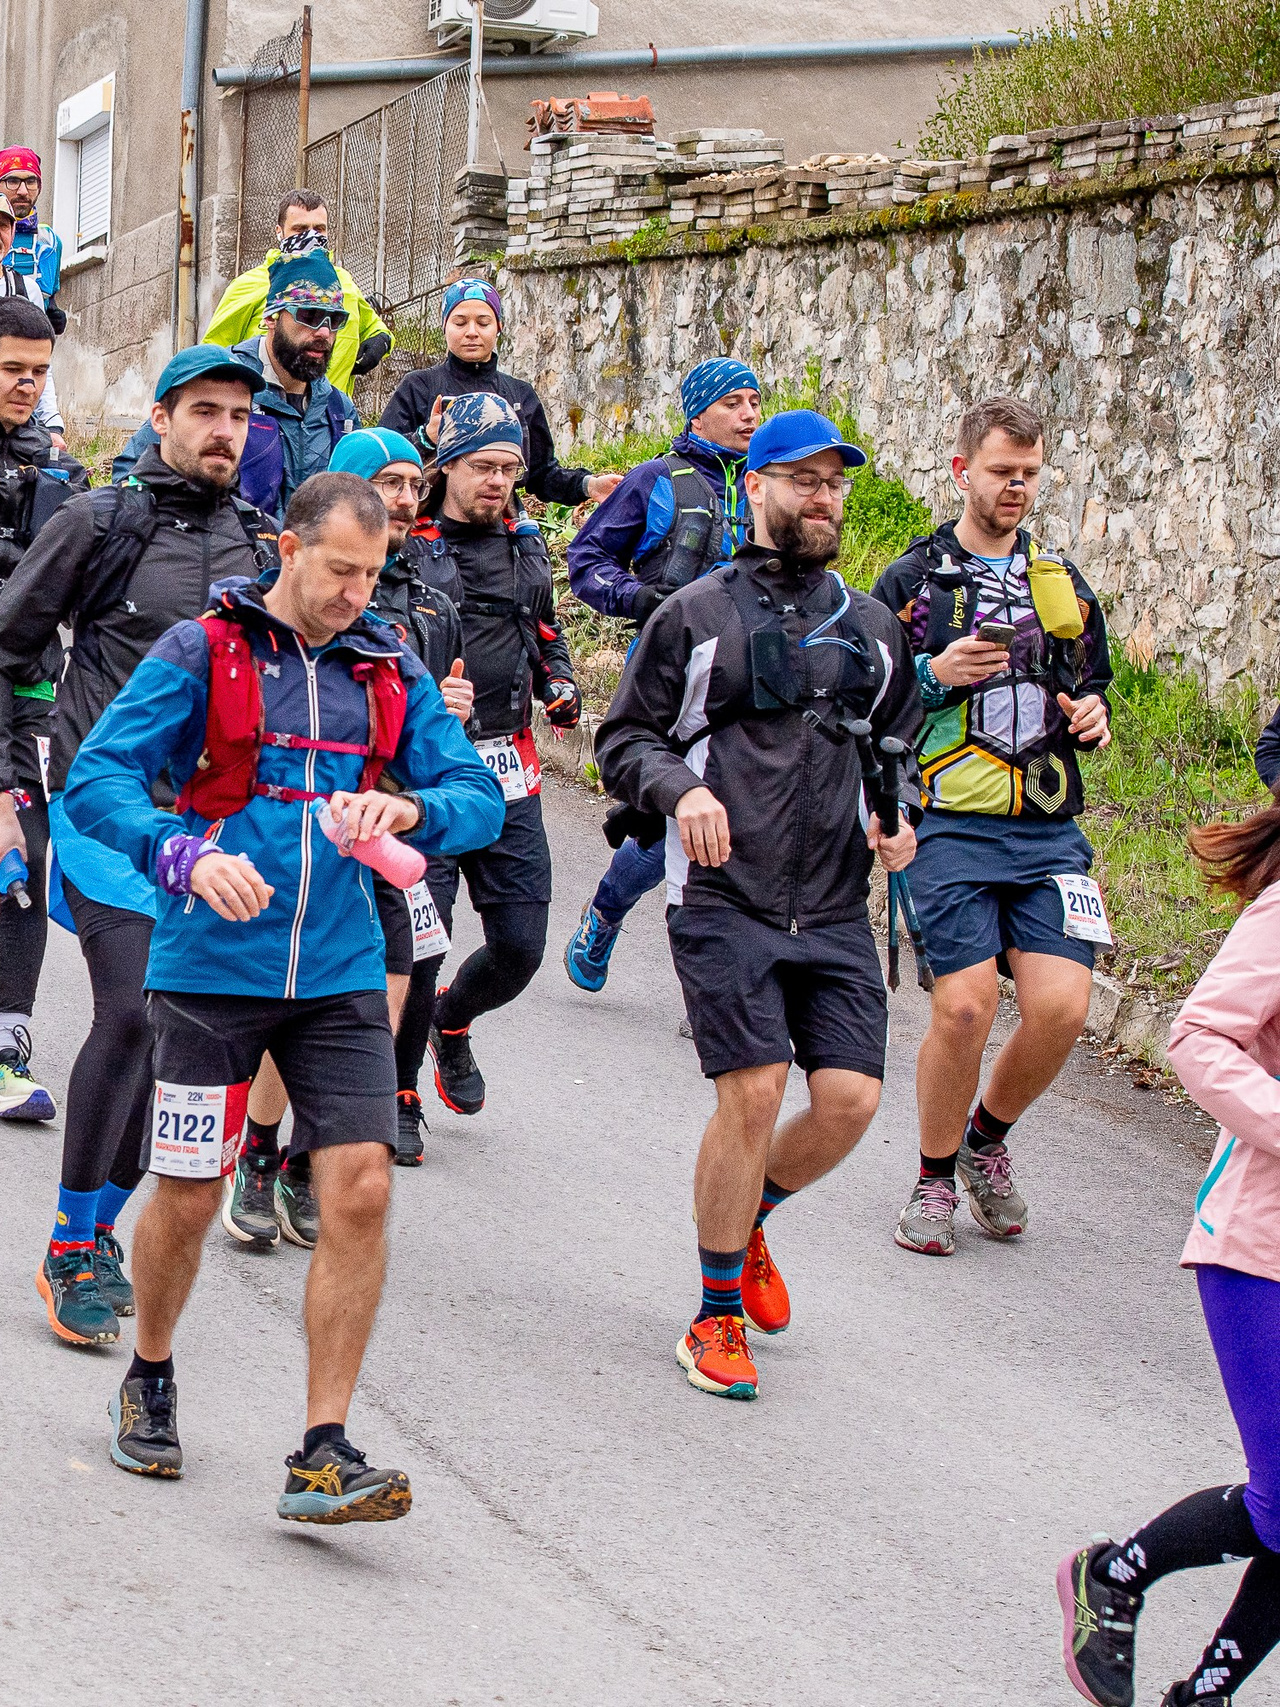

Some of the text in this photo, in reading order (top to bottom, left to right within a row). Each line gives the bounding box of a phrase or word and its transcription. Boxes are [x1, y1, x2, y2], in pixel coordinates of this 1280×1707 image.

[413, 902, 441, 933] 237
[1067, 891, 1102, 918] 2113
[187, 1091, 204, 1102] 22K
[157, 1110, 216, 1143] 2122
